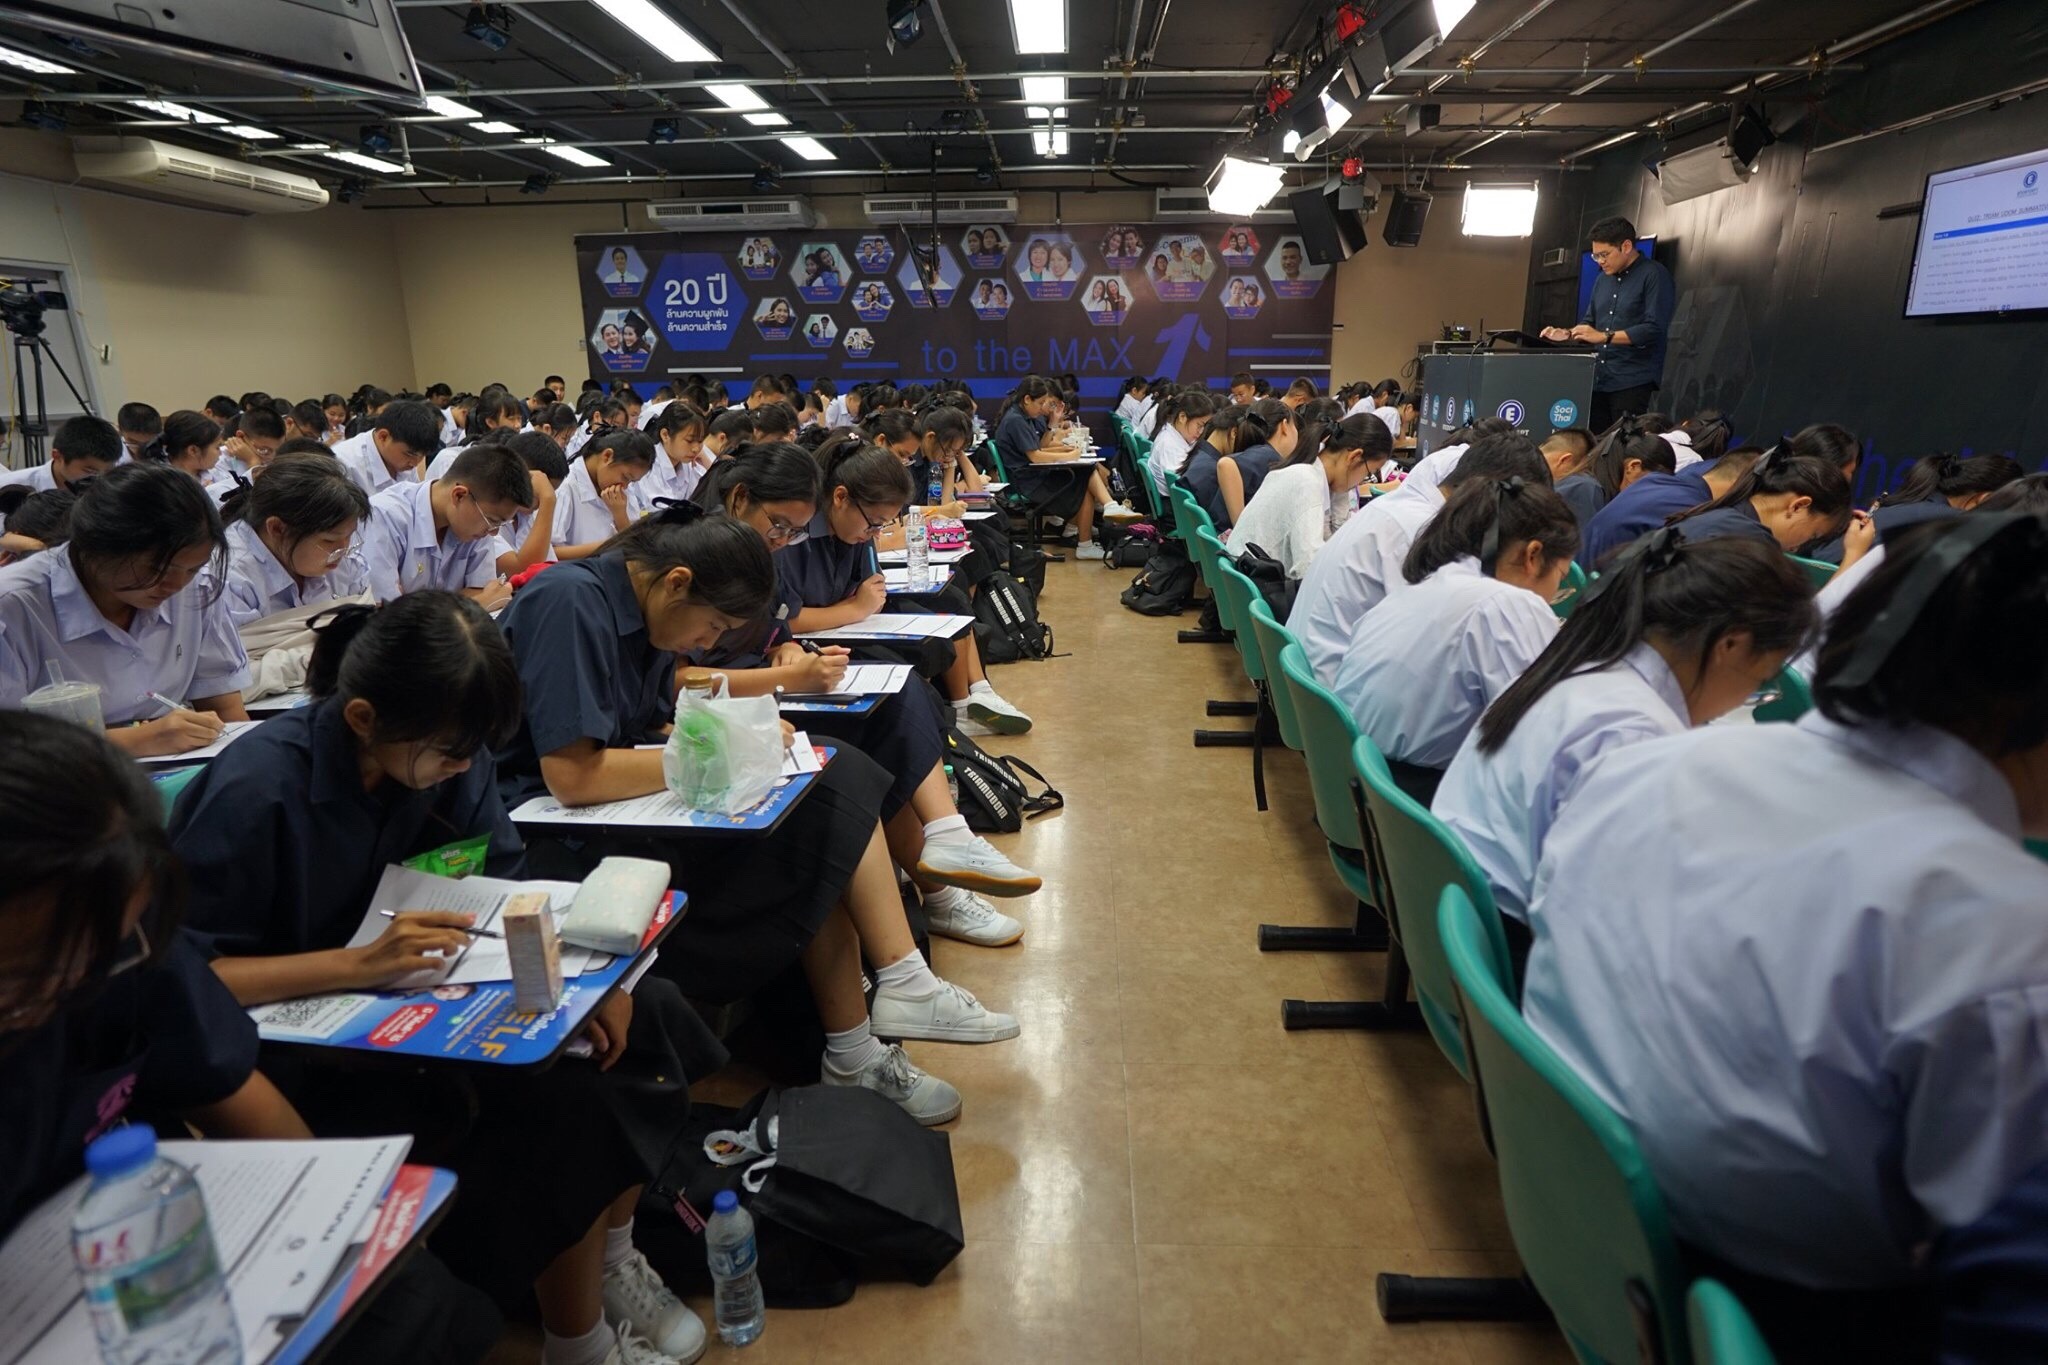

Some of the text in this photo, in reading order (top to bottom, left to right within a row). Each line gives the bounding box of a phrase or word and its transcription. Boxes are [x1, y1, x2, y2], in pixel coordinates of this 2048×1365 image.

[664, 279, 700, 305] 20
[706, 273, 728, 305] ปี
[666, 308, 729, 321] ล้านความผูกพัน
[667, 320, 727, 332] ล้านความสำเร็จ
[921, 335, 1135, 373] to the MAX
[964, 767, 1008, 819] TRIAMUDOM
